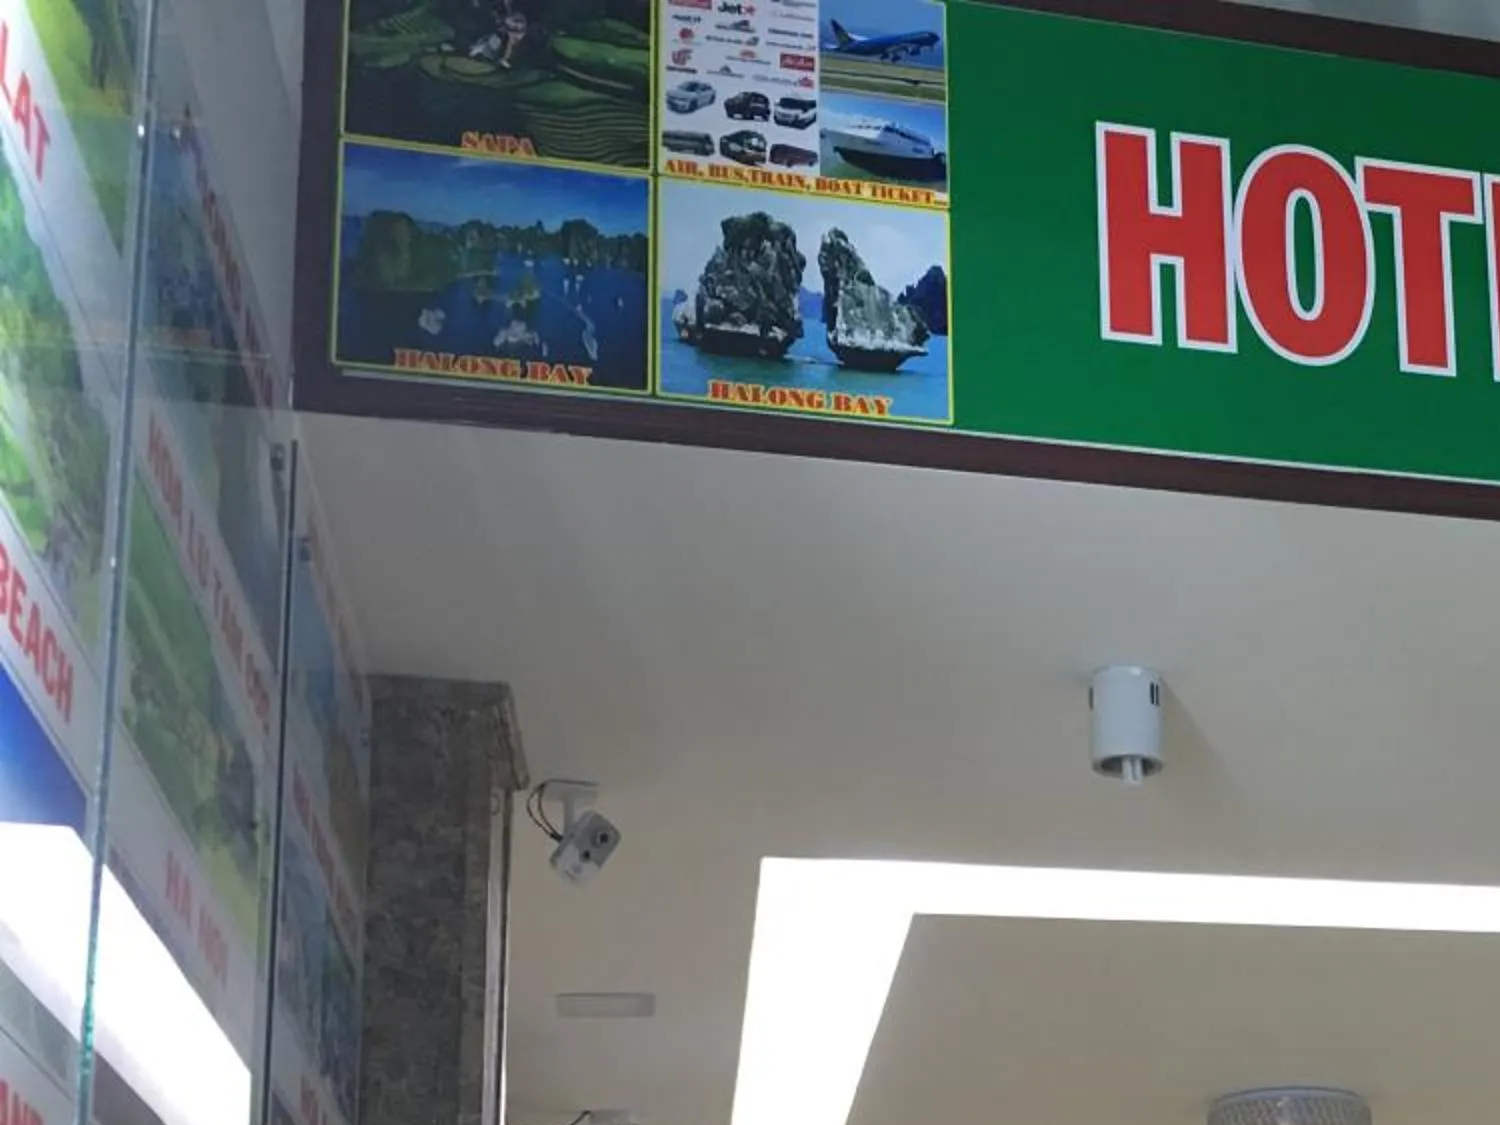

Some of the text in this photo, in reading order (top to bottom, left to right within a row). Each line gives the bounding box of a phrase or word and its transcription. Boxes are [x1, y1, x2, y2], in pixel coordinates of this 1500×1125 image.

[462, 131, 537, 157] SAPA
[815, 176, 863, 195] BOAT
[394, 348, 592, 386] HALONG BAY
[709, 379, 893, 417] HALONG BAY
[0, 541, 74, 724] BEACH
